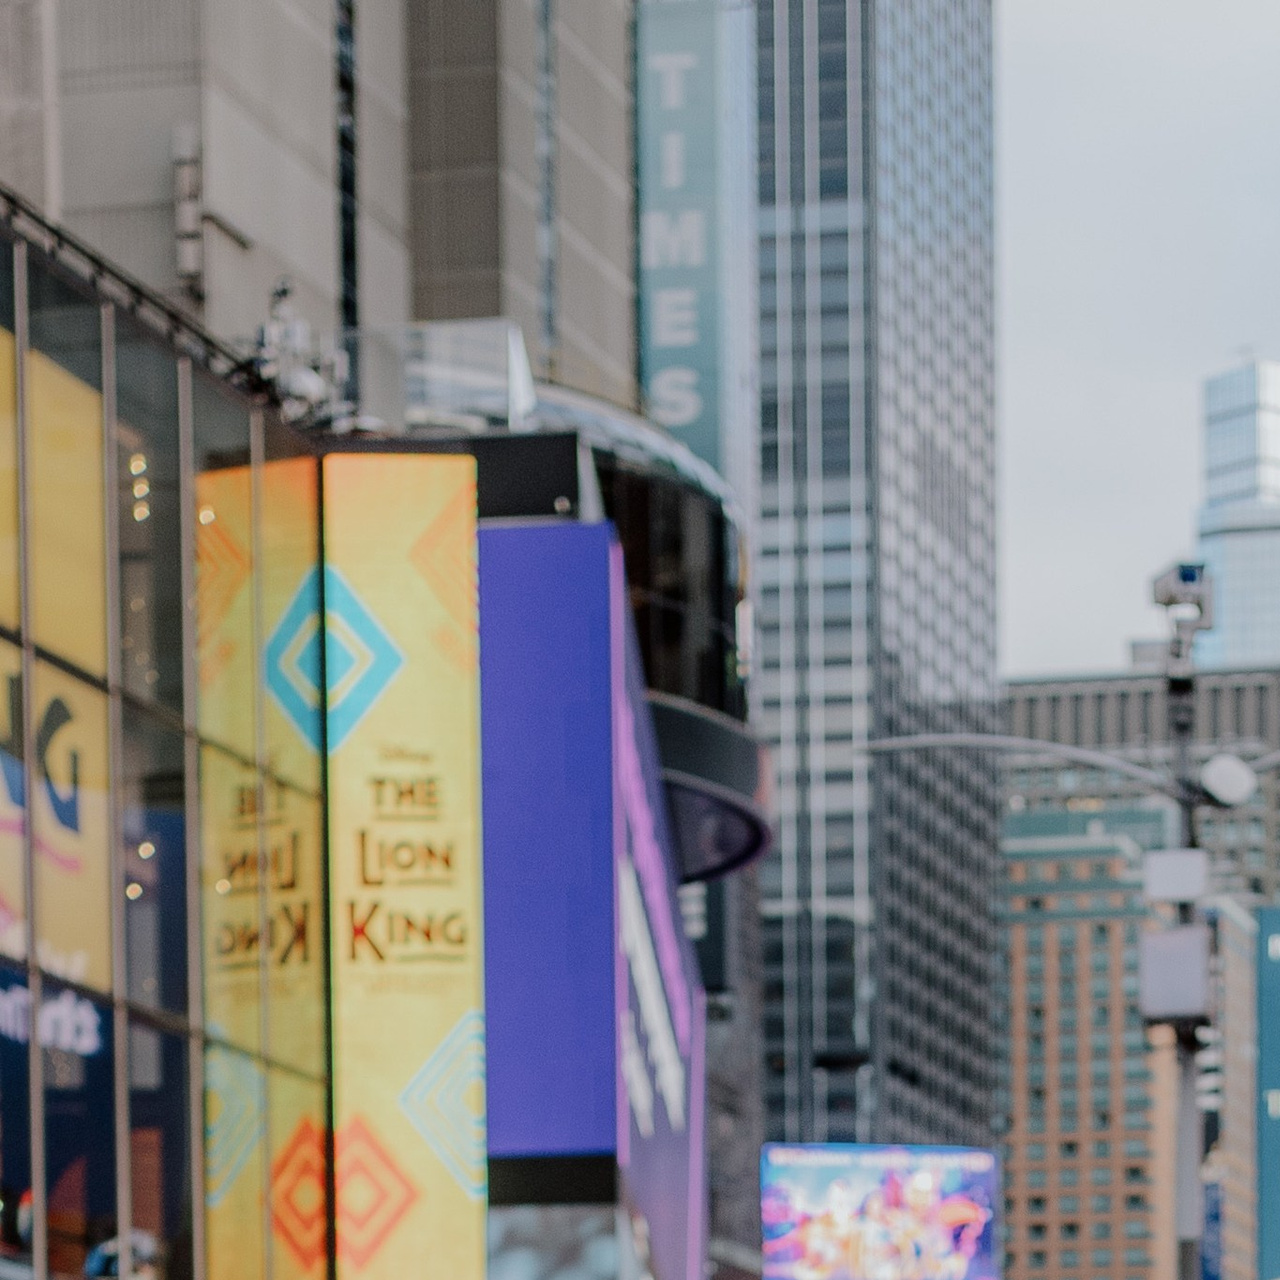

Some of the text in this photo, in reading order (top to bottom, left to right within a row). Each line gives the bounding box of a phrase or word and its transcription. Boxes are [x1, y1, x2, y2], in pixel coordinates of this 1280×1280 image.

[641, 52, 706, 427] TIMES
[369, 776, 441, 808] THE
[348, 900, 468, 961] KING
